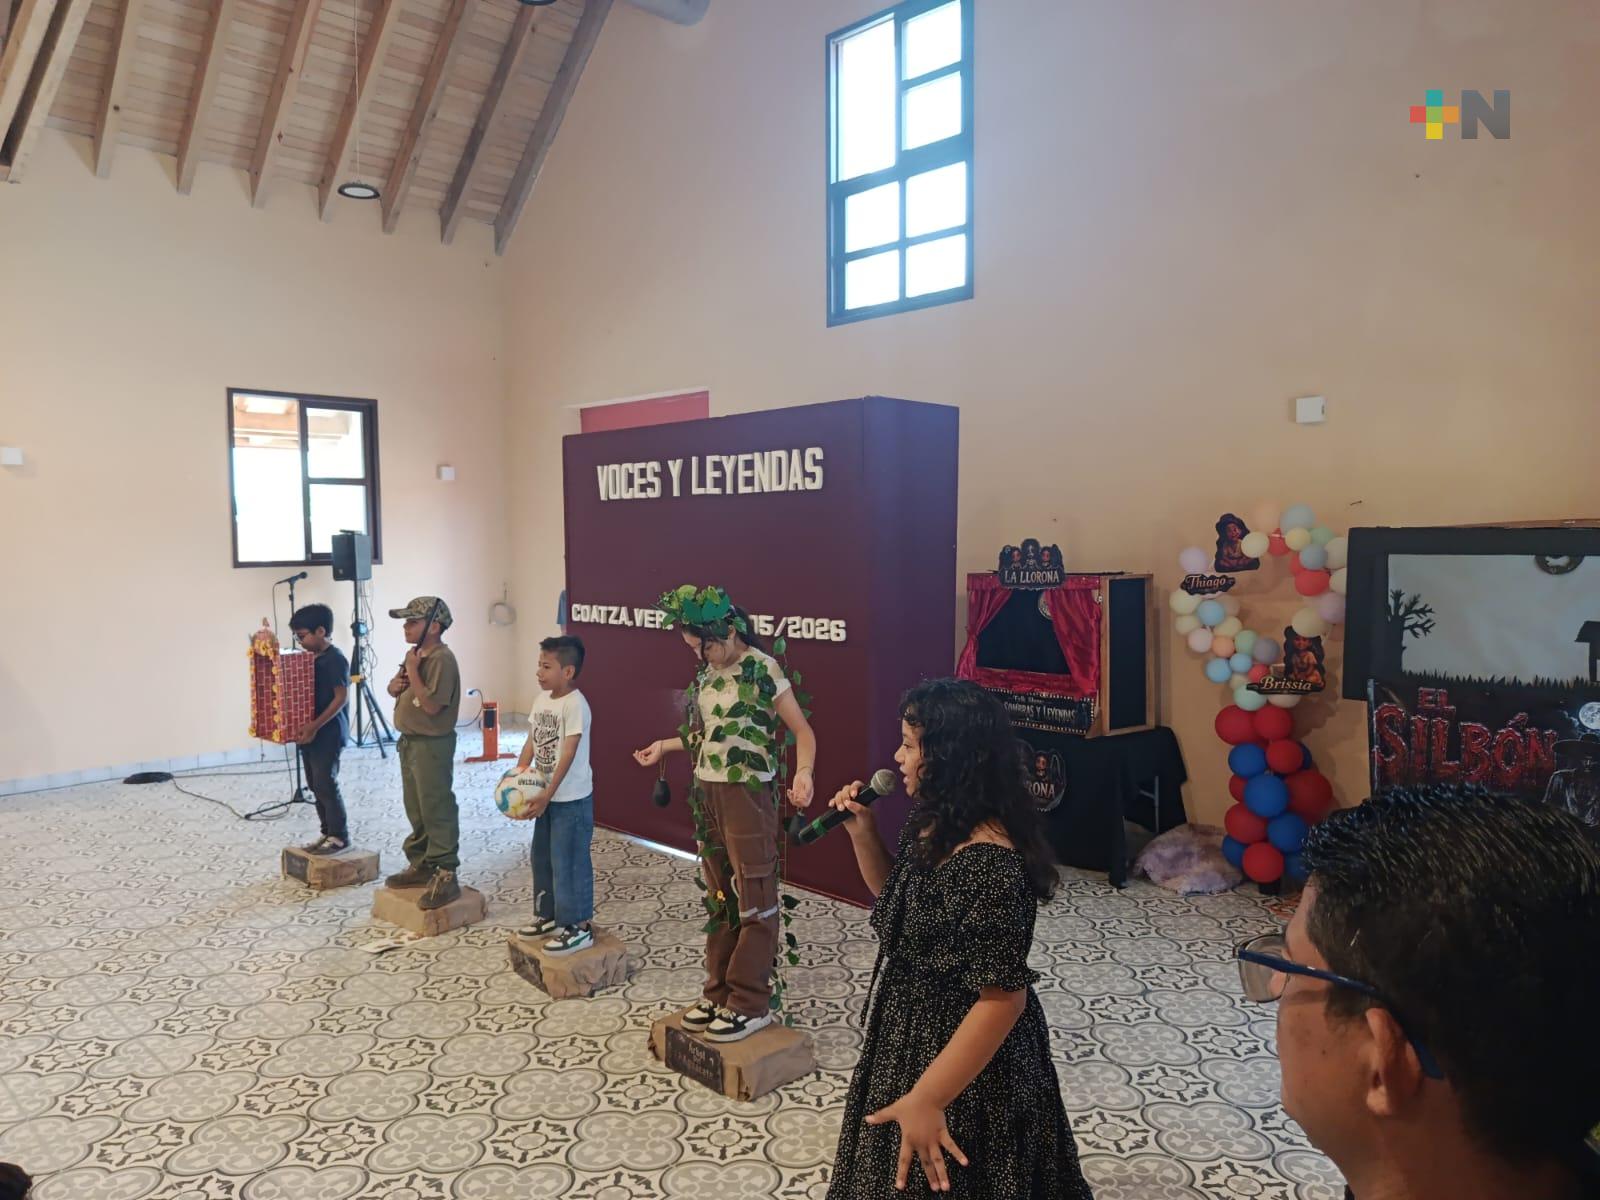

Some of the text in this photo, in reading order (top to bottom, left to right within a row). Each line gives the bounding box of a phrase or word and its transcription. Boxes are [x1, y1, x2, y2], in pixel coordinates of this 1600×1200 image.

[596, 447, 824, 501] VOCES Y LEYENDAS
[1004, 570, 1060, 585] LA LLORONA
[1184, 574, 1226, 590] Thiago
[1260, 675, 1313, 692] Brissia
[1418, 686, 1456, 714] EL
[1035, 705, 1042, 718] Y
[1043, 705, 1077, 724] LEYENDAS
[1373, 702, 1559, 787] SILBÓN
